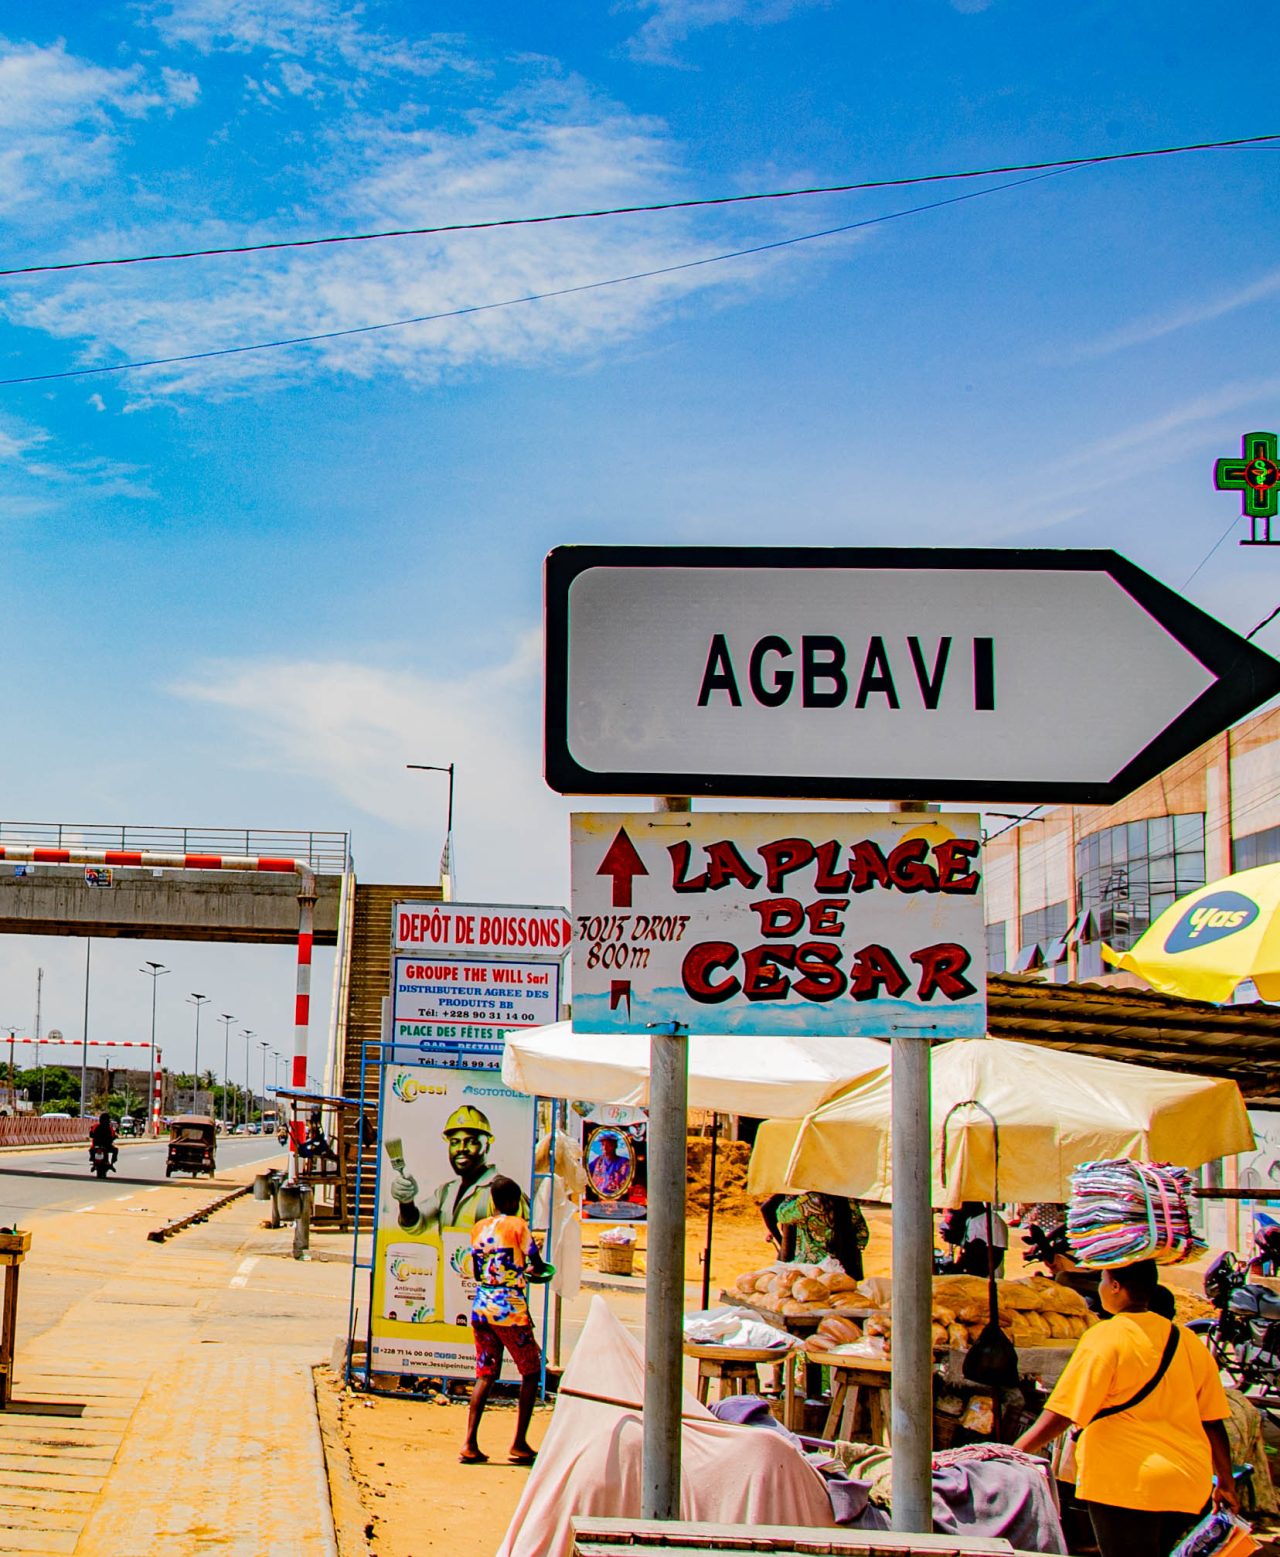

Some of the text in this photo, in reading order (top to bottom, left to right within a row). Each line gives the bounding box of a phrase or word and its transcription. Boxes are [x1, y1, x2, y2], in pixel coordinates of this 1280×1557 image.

[697, 633, 995, 711] AGBAVI
[399, 907, 560, 948] DEPÔT DE BOISSONS
[577, 915, 691, 942] TOUT DROIT
[750, 898, 851, 938] DE
[406, 965, 548, 985] GROUPE THE WILL Sarl
[682, 941, 979, 1004] CESAR
[399, 984, 549, 999] DISTRIBUTEUR AGREE DES
[418, 1008, 438, 1017] Tél:
[442, 1010, 469, 1018] +228
[489, 1012, 501, 1020] 31
[506, 1012, 518, 1020] 14
[521, 1013, 535, 1021] 00
[438, 998, 514, 1009] PRODUITS BB
[400, 1025, 432, 1037] PLACE
[436, 1026, 456, 1038] DES
[460, 1025, 493, 1039] FÊTES
